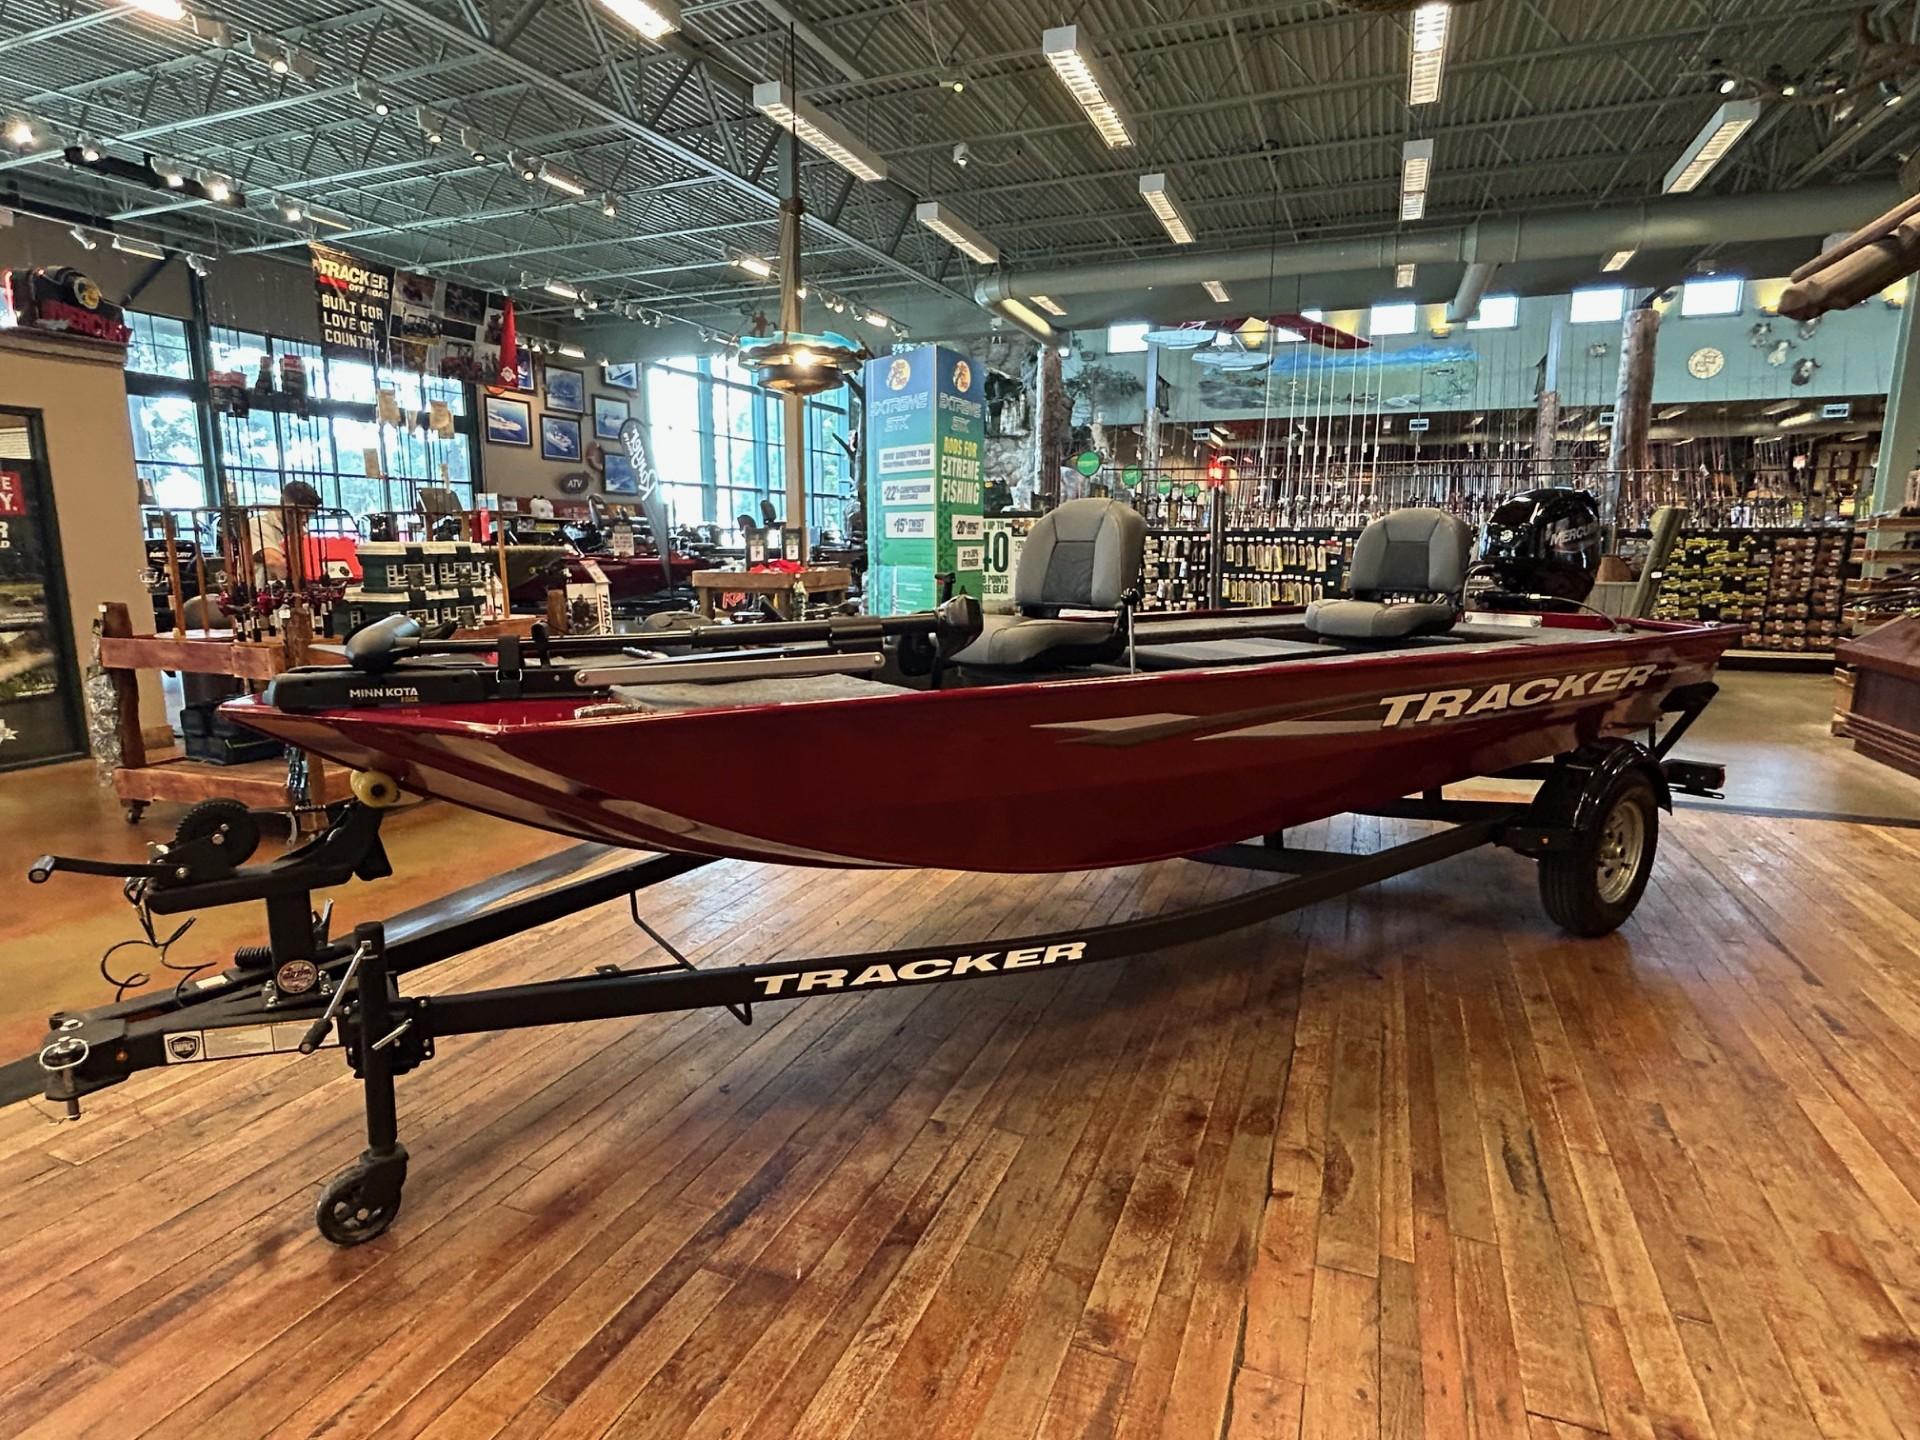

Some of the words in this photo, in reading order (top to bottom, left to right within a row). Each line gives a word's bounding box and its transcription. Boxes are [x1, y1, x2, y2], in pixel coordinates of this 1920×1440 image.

[319, 259, 388, 291] TRACKER
[348, 282, 365, 294] OFF
[366, 287, 389, 300] ROAD
[321, 293, 357, 315] BUILT
[360, 303, 384, 320] FOR
[322, 311, 357, 330] LOVE
[359, 320, 374, 335] OF
[943, 436, 962, 456] RODS
[963, 440, 978, 459] FOR
[941, 455, 981, 480] EXTREME
[567, 479, 583, 488] ATV
[941, 479, 980, 505] FISHING
[993, 584, 1009, 594] GEAR
[349, 688, 384, 698] MINN
[385, 687, 419, 697] KOTA
[1379, 664, 1657, 728] TRACKER
[754, 941, 1088, 995] TRACKER
